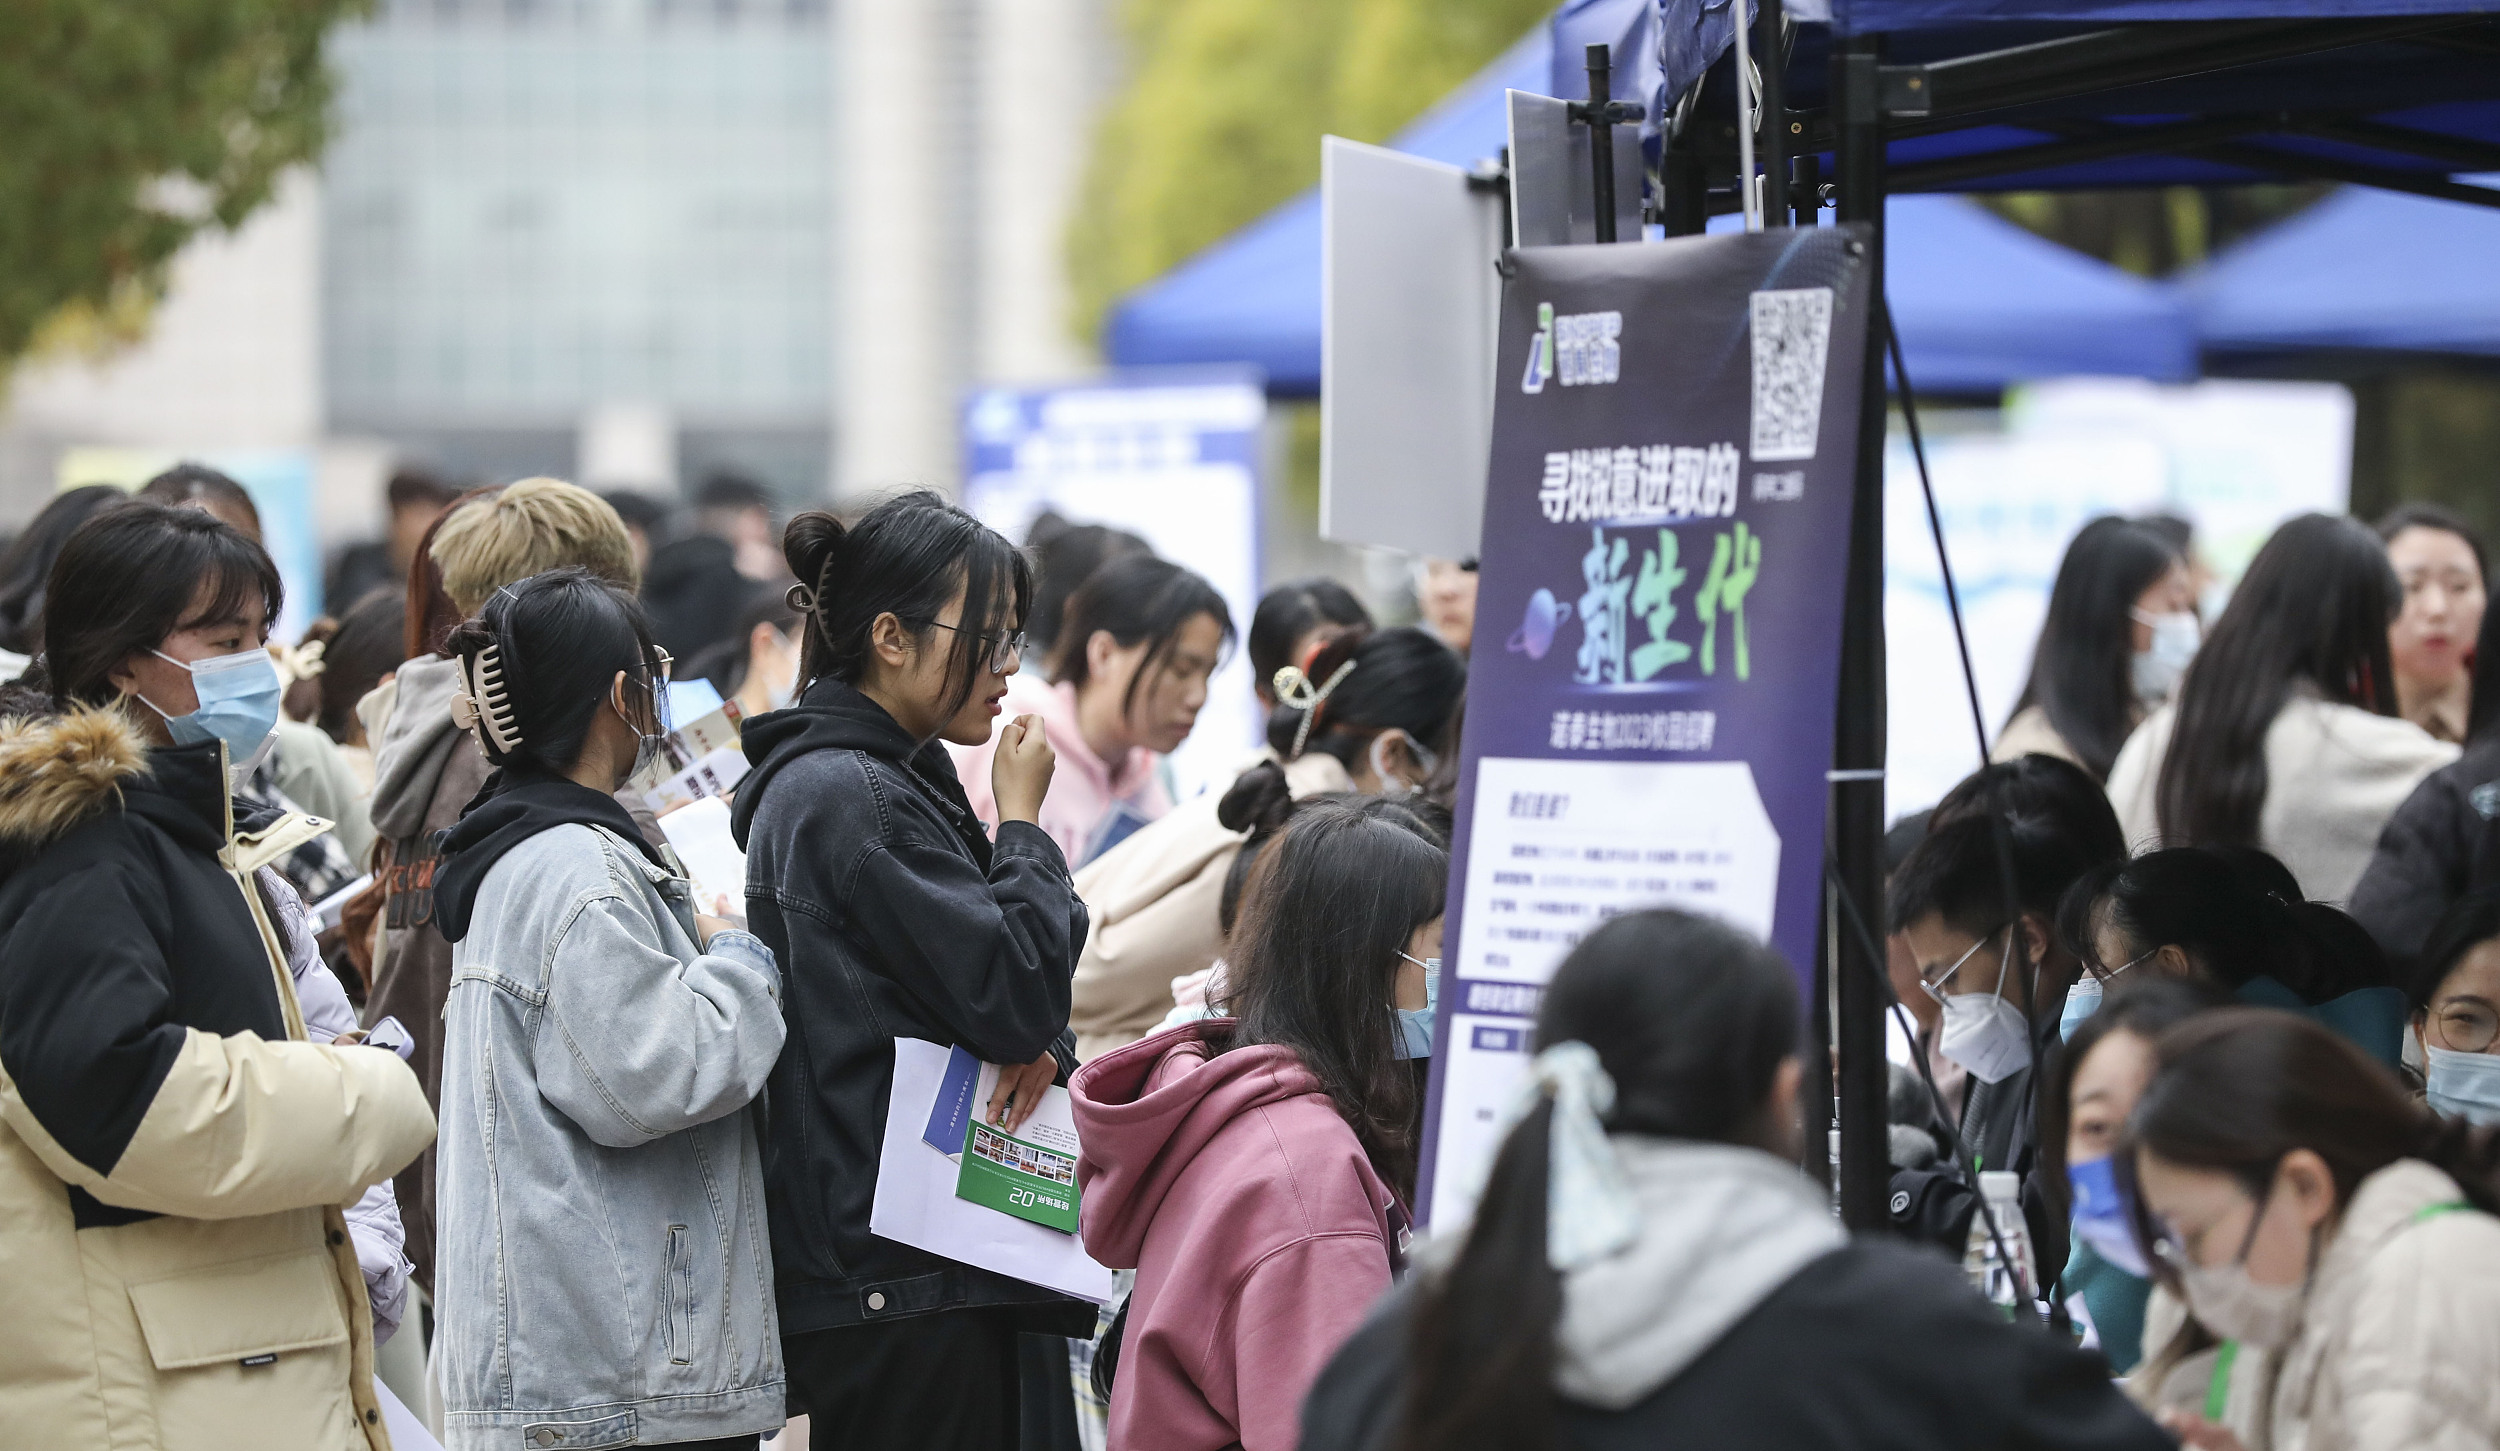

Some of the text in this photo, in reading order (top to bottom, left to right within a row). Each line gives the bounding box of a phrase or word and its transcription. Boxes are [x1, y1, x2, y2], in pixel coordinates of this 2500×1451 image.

[1573, 521, 1761, 684] 新生代
[1008, 1187, 1069, 1211] 经营场所 02
